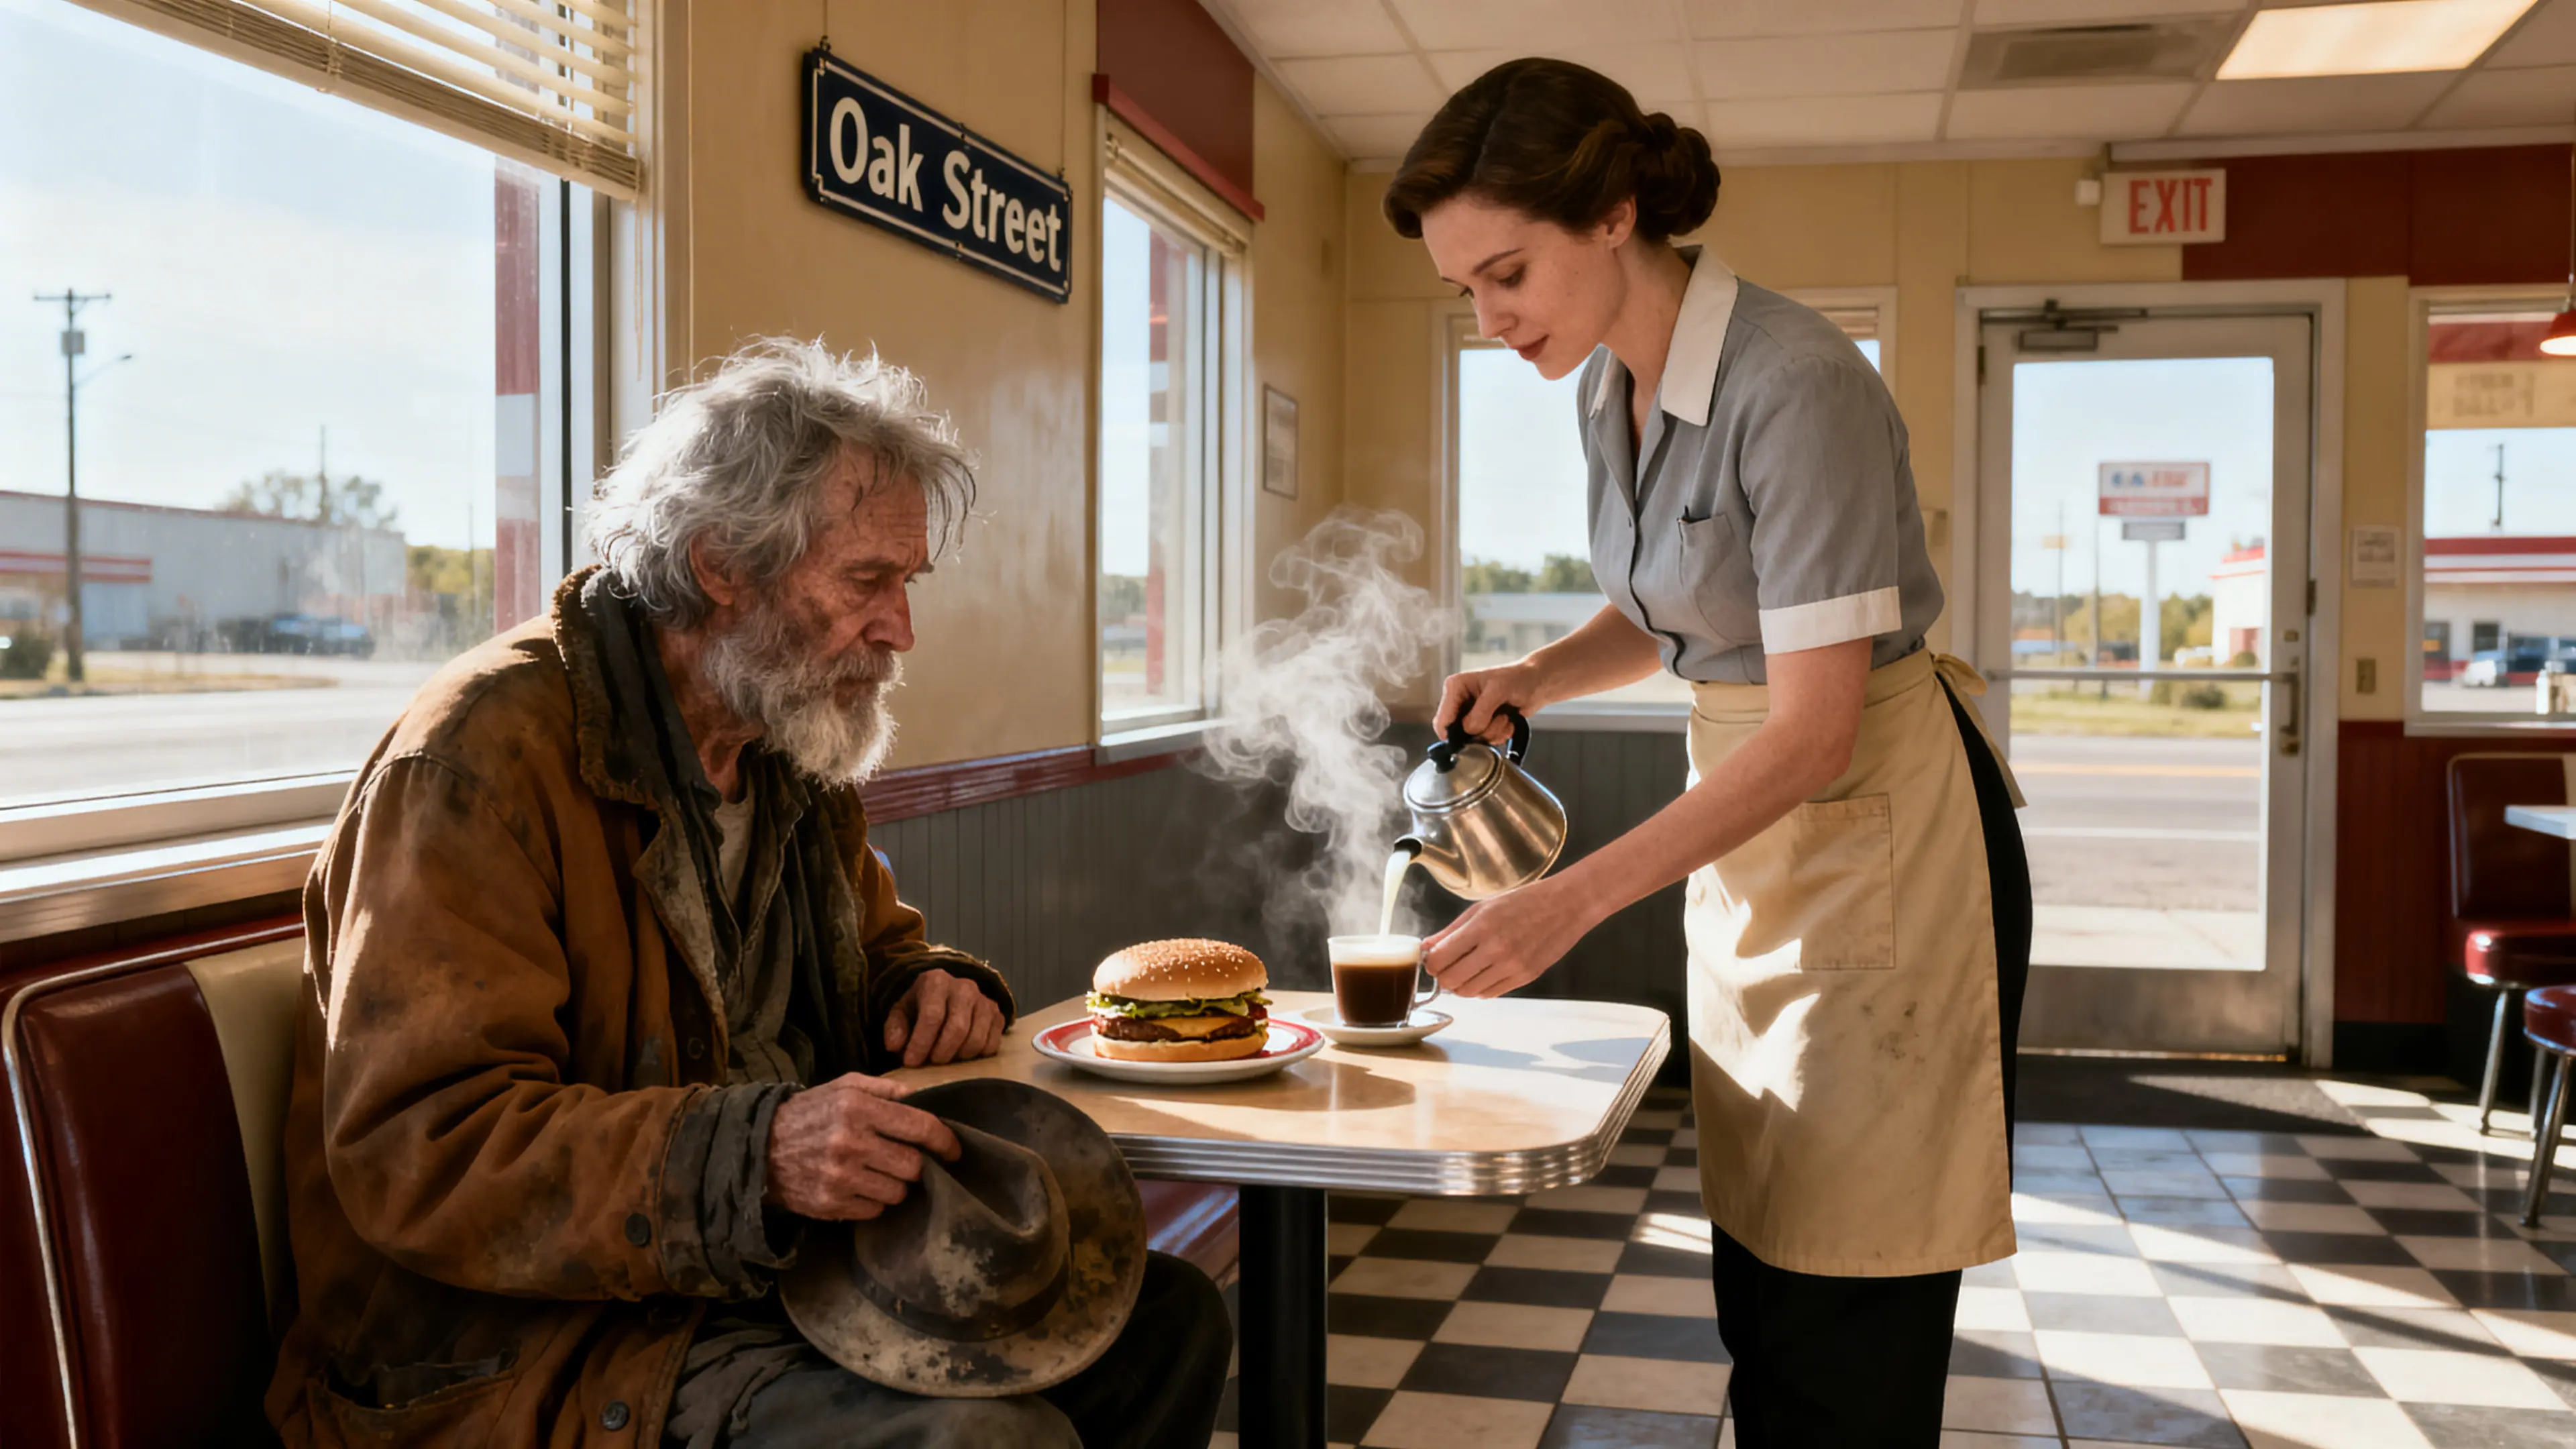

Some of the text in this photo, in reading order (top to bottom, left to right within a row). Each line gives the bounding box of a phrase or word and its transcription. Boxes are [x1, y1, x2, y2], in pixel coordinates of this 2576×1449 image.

[829, 97, 1062, 272] Oak Street
[2129, 177, 2213, 234] EXIT
